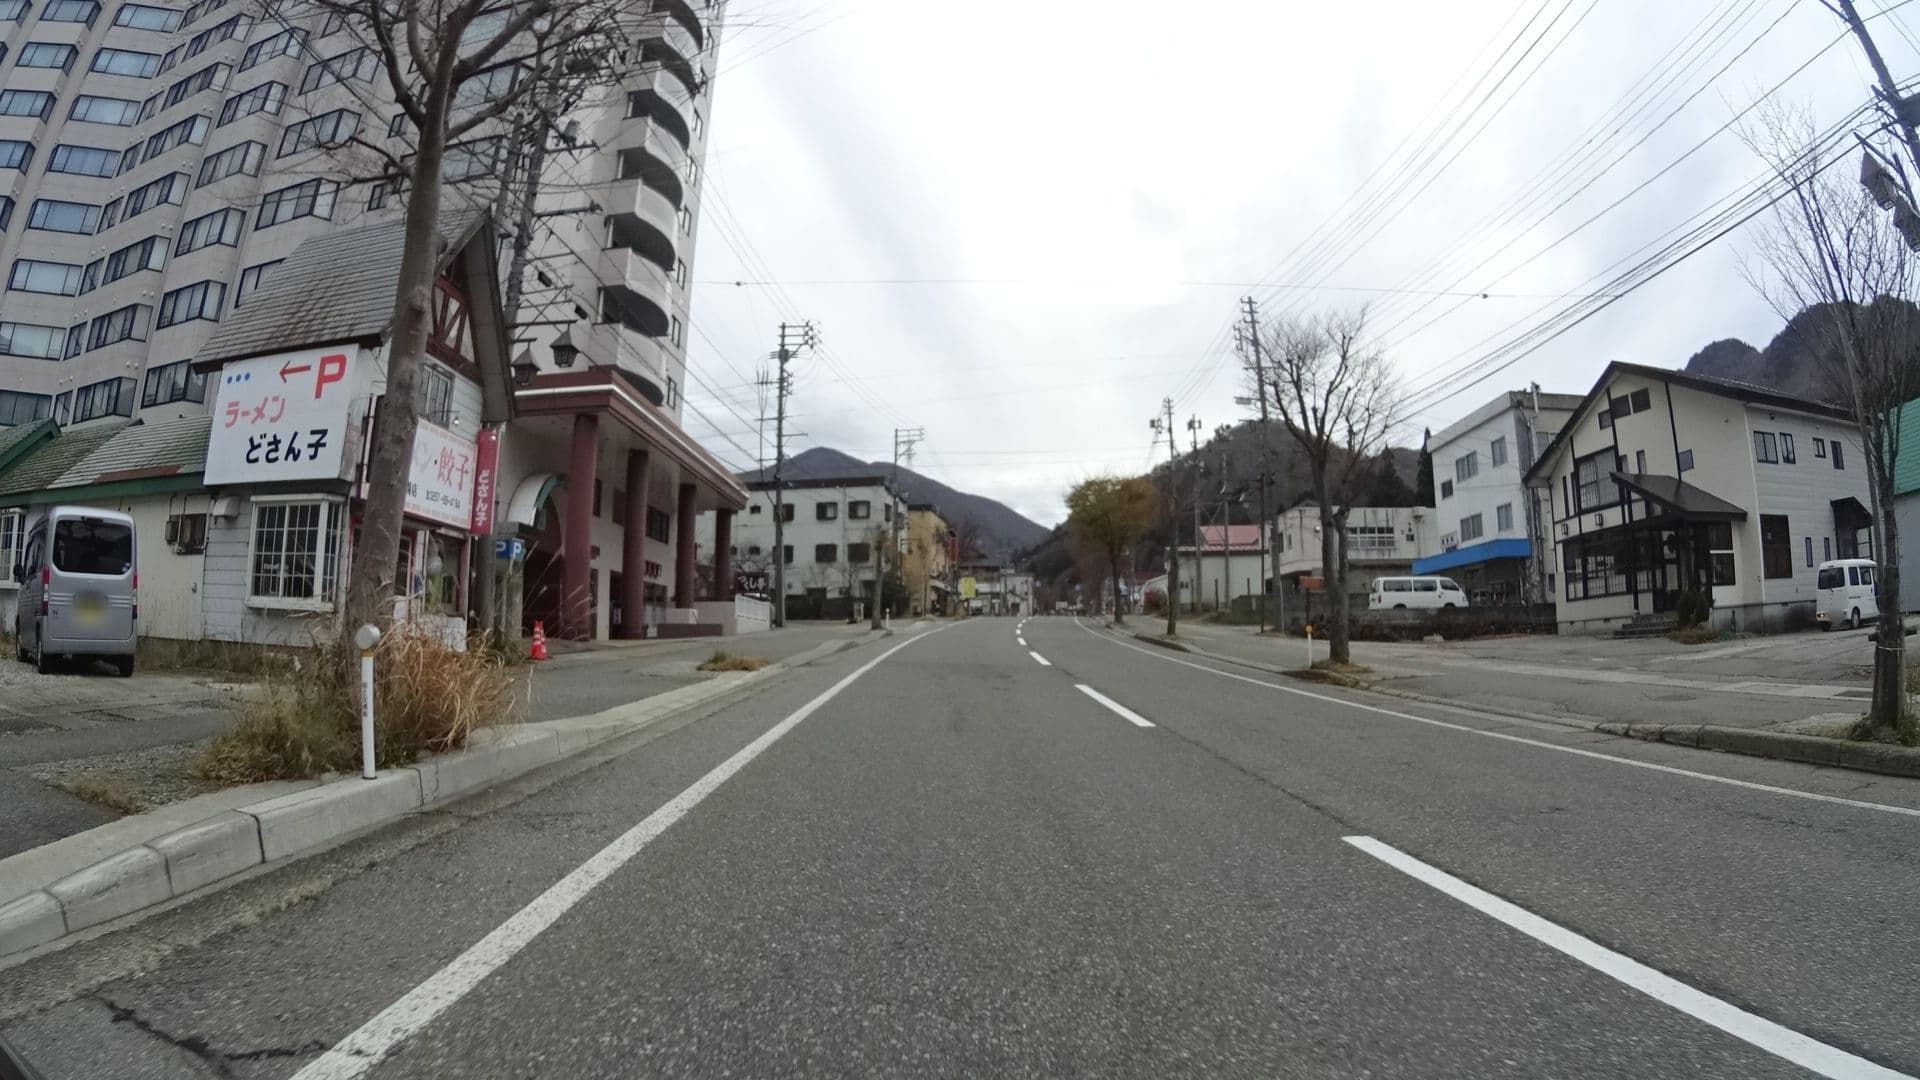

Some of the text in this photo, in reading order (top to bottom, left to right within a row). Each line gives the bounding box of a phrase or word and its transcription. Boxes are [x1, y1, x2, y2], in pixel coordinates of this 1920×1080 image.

[314, 353, 347, 399] P
[225, 395, 286, 428] ラーメン
[245, 428, 329, 464] どさん子
[476, 469, 490, 526] どさん子
[513, 542, 522, 558] P
